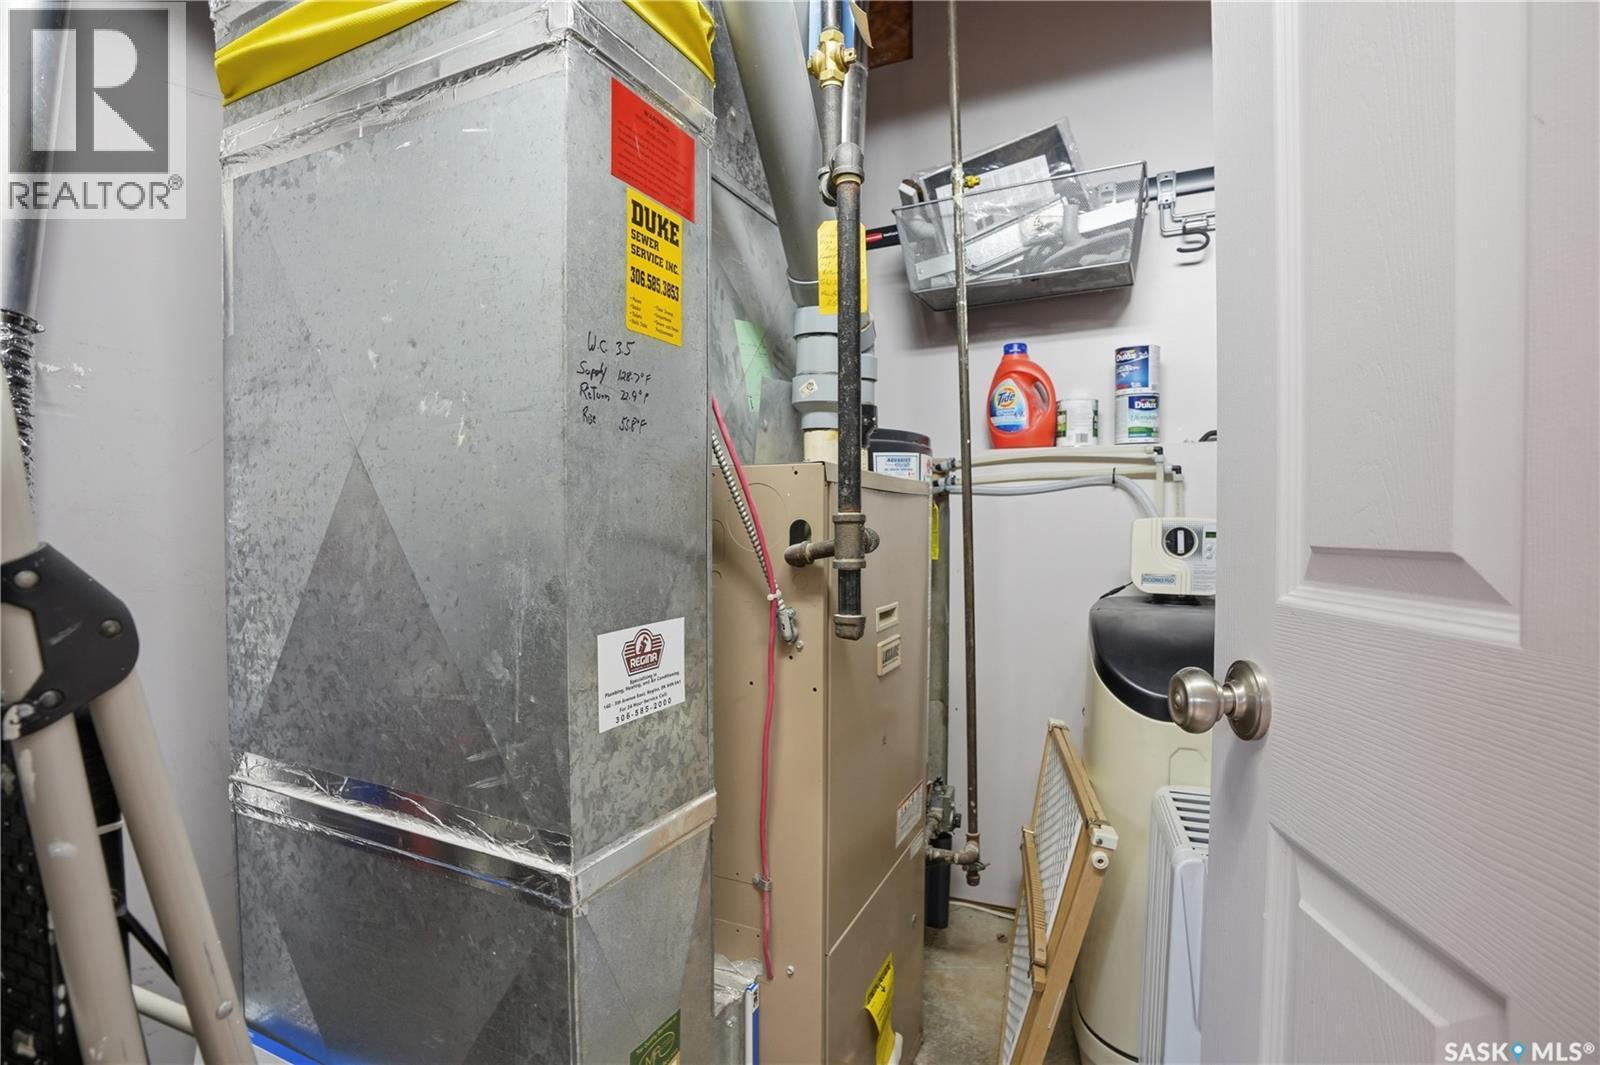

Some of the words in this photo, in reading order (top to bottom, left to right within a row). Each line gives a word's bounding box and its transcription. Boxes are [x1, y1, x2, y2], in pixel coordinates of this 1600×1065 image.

[631, 199, 680, 247] DUKE
[631, 228, 659, 251] SEWER
[631, 244, 664, 269] SERVICE
[665, 257, 680, 276] INC.
[630, 266, 680, 302] 306.585.3853
[997, 391, 1016, 407] Tide
[1134, 401, 1157, 409] Dulux
[630, 652, 658, 669] REGINA
[615, 697, 672, 724] 306-585-2000
